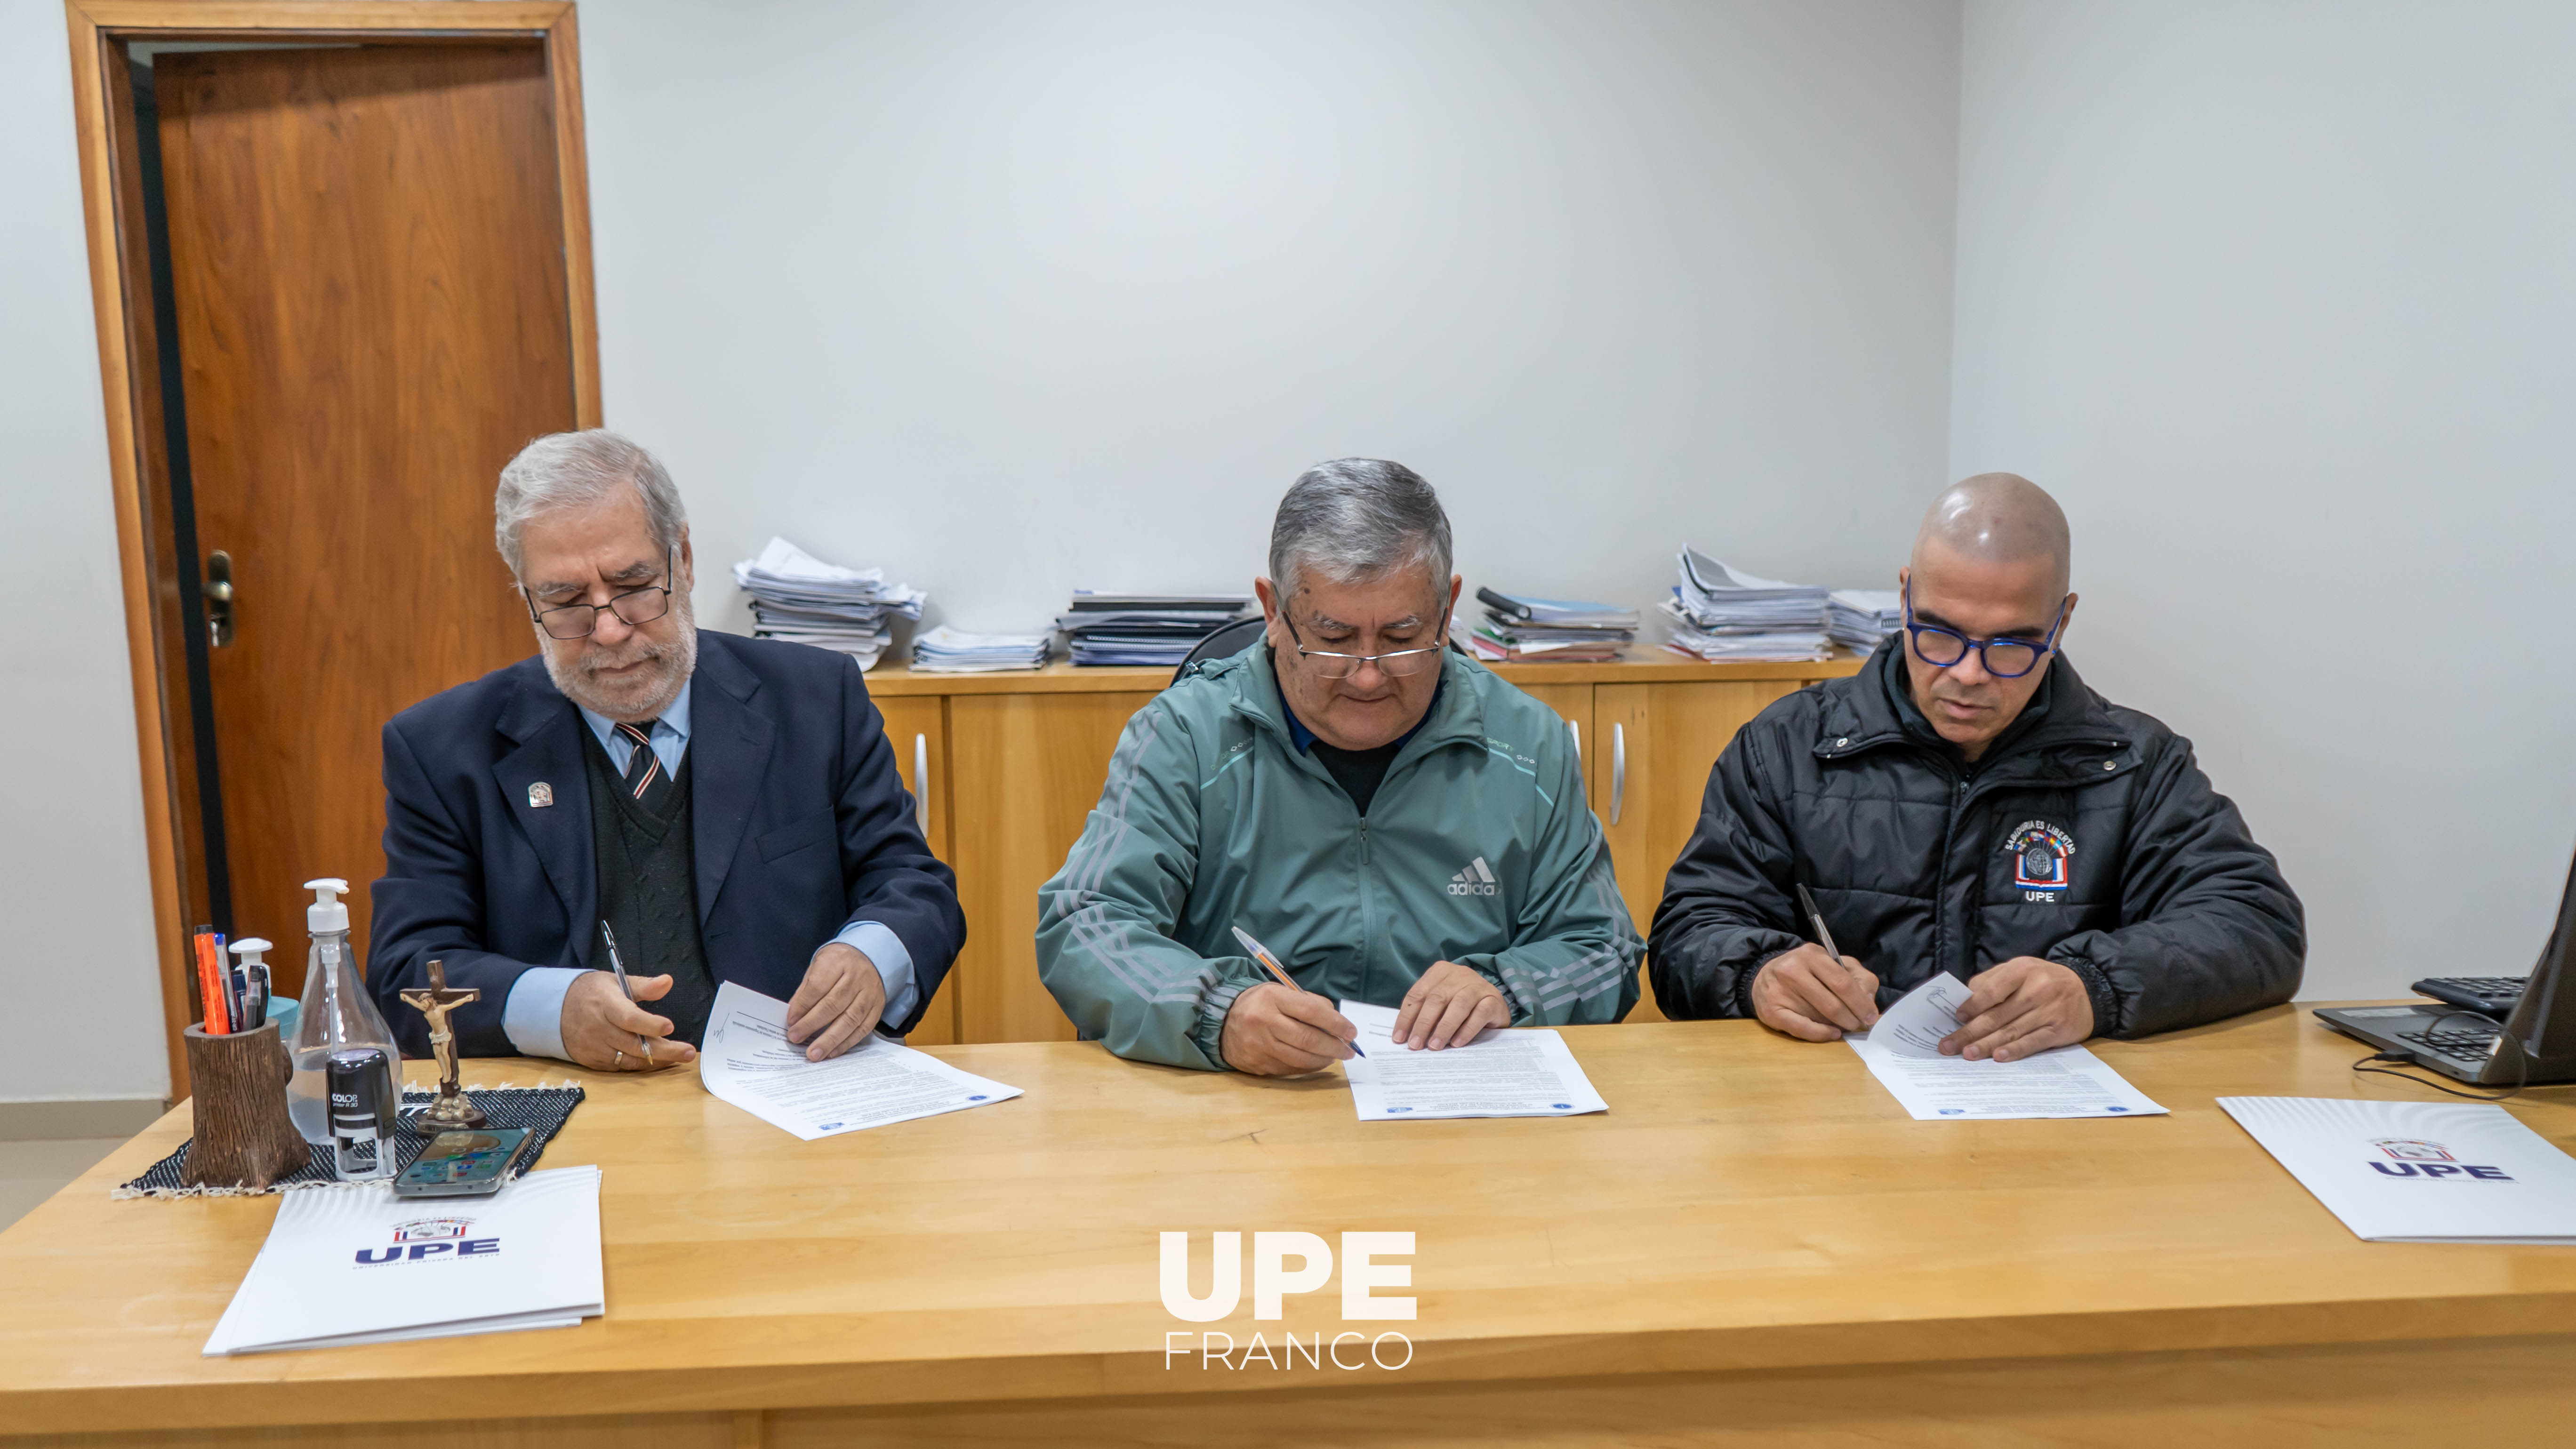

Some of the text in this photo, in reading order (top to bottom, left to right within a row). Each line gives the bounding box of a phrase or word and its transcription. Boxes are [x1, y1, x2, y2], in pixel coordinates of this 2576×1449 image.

[2005, 820, 2076, 854] SABIDURIA ES LIBERTAD
[2025, 891, 2055, 902] UPE
[2368, 1161, 2516, 1181] UPE
[355, 1237, 500, 1264] UPE
